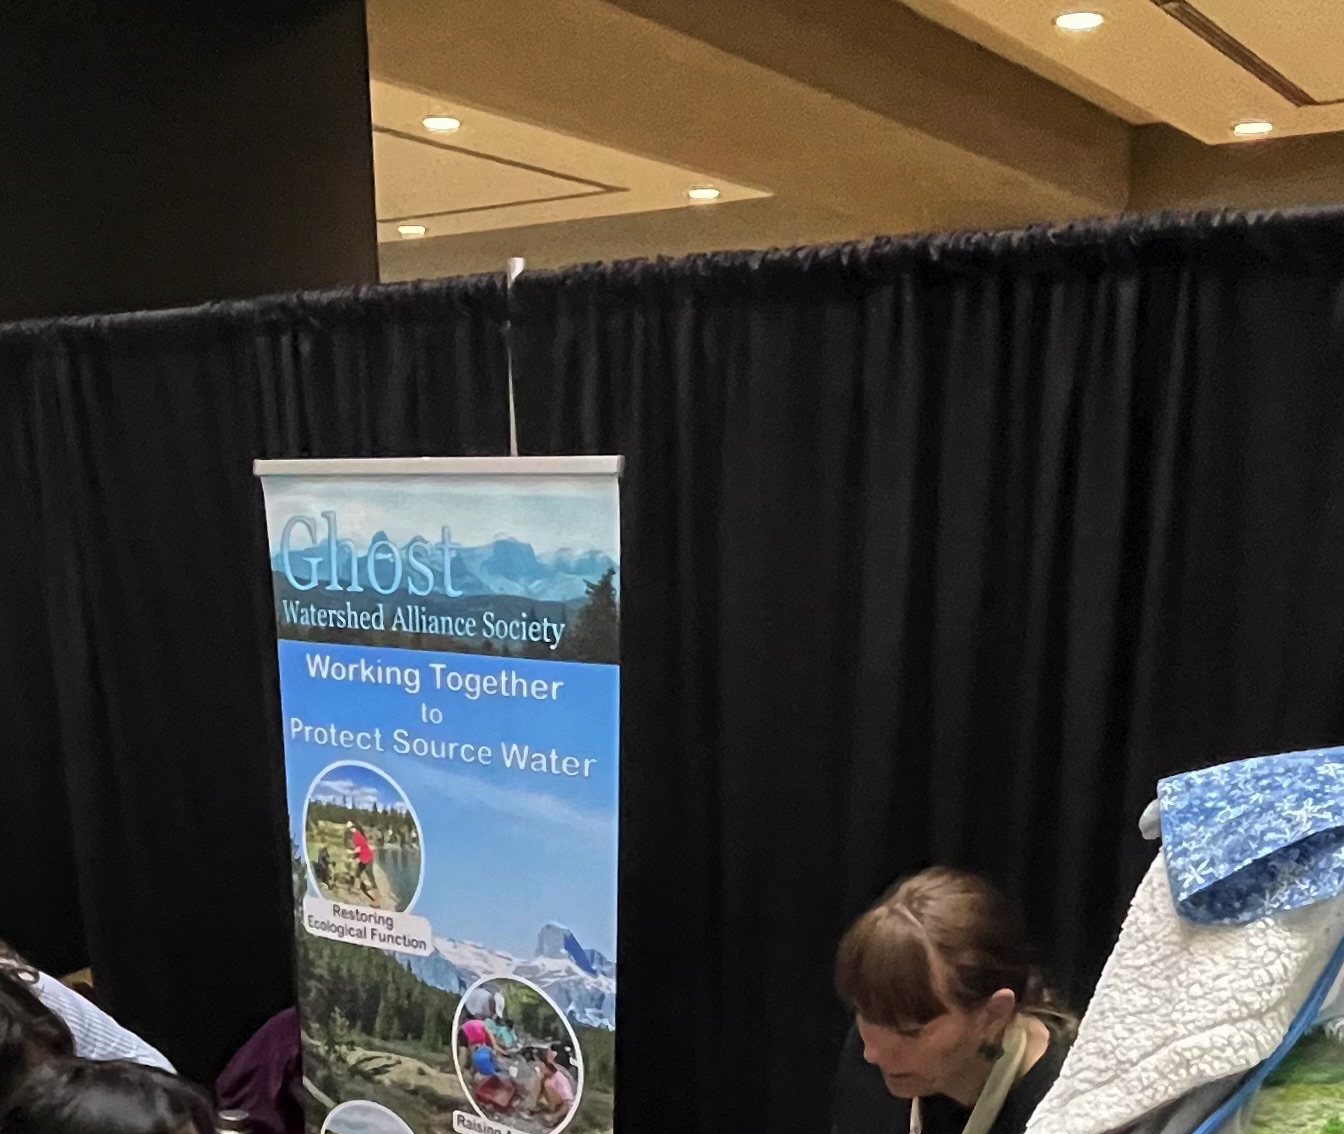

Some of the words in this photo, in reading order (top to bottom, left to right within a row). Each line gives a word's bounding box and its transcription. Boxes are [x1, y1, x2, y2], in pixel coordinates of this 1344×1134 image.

[279, 511, 463, 598] Ghost
[282, 600, 385, 631] Watershed
[392, 605, 477, 637] Alliance
[482, 613, 565, 649] Society
[305, 653, 421, 693] Working
[429, 663, 564, 700] Together
[421, 703, 443, 724] to
[290, 717, 384, 752] Protect
[393, 729, 492, 765] Source
[501, 742, 597, 778] Water
[307, 914, 367, 939] Ecological
[371, 928, 427, 951] Function
[332, 904, 394, 931] Restoring
